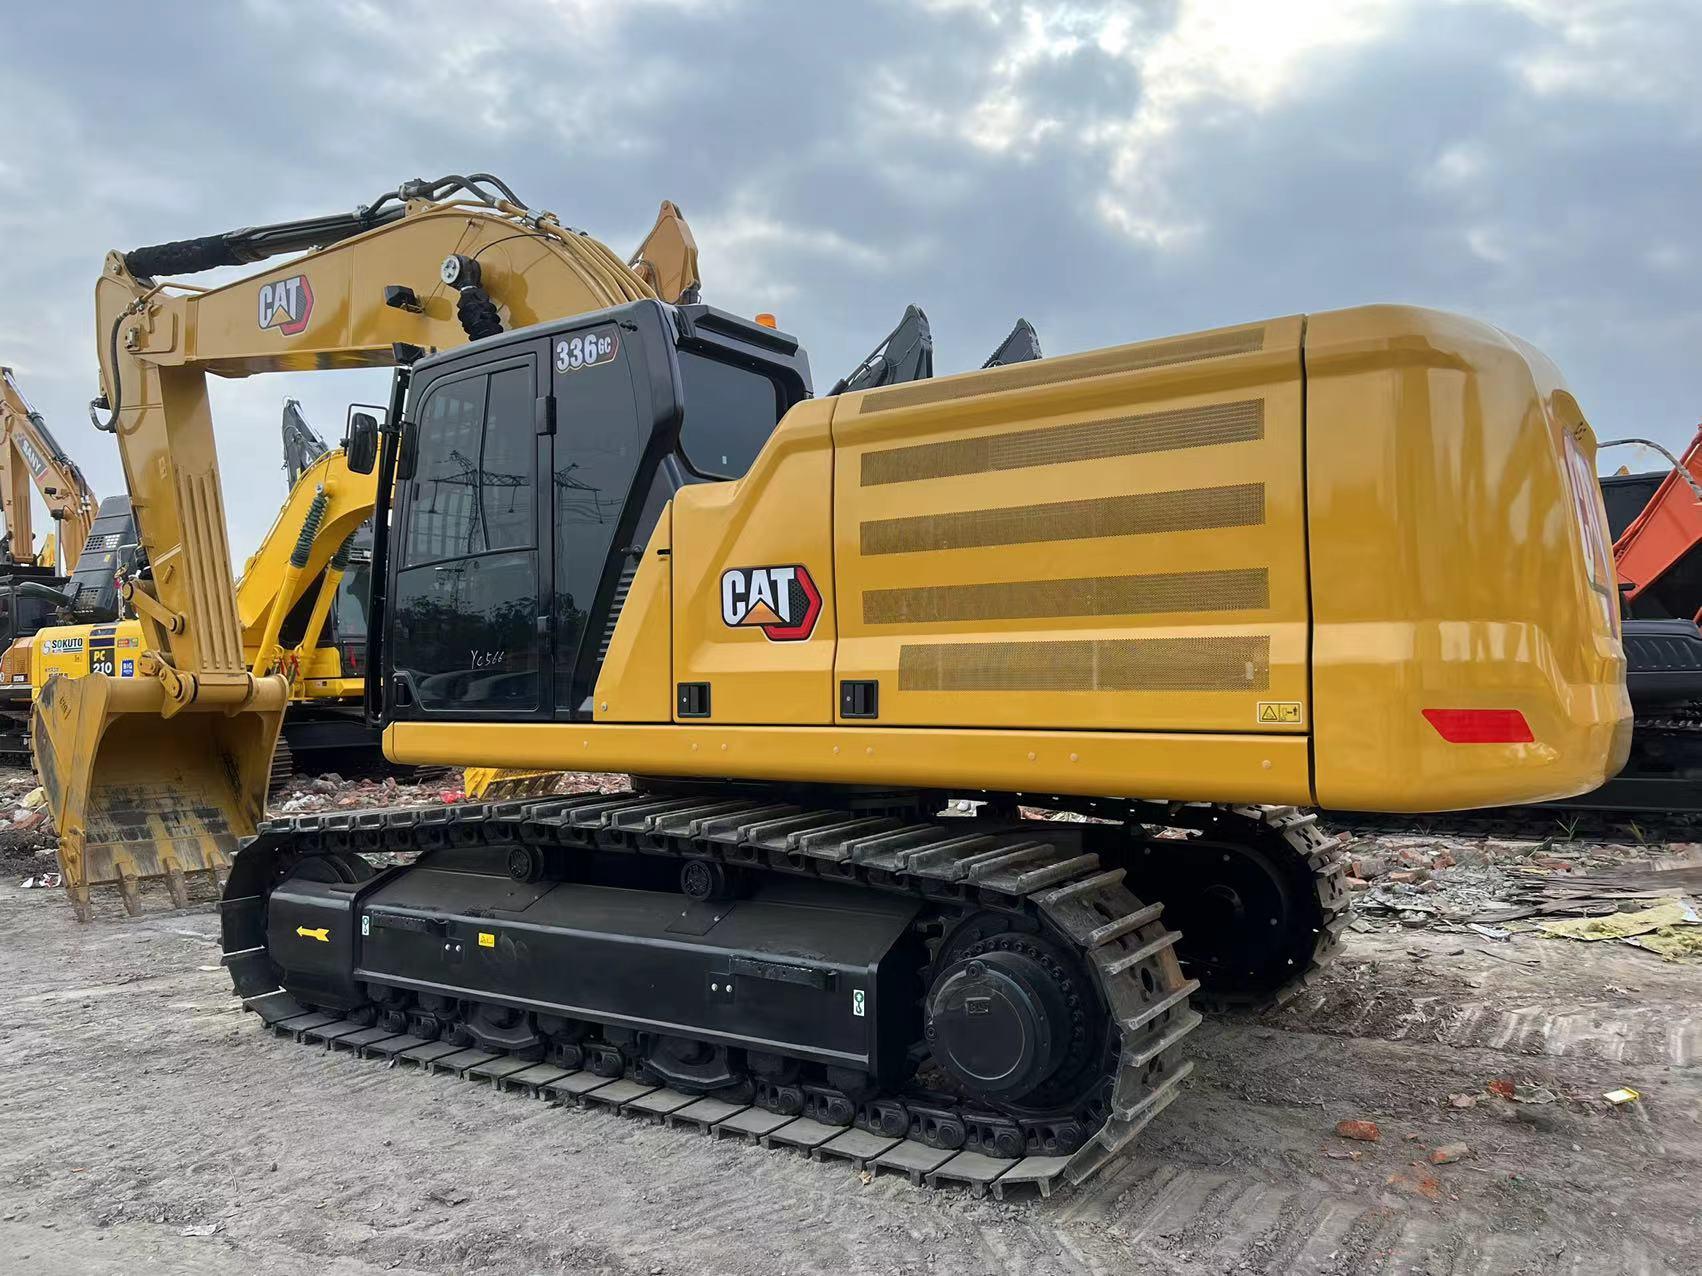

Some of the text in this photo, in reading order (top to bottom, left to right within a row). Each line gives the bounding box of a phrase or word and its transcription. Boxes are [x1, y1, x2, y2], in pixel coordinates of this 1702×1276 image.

[259, 277, 300, 328] CAT
[556, 334, 597, 371] 336
[22, 440, 41, 471] SANY
[722, 567, 795, 625] CAT
[52, 638, 83, 649] SOKUTO
[94, 650, 106, 662] PC
[93, 662, 112, 675] 210
